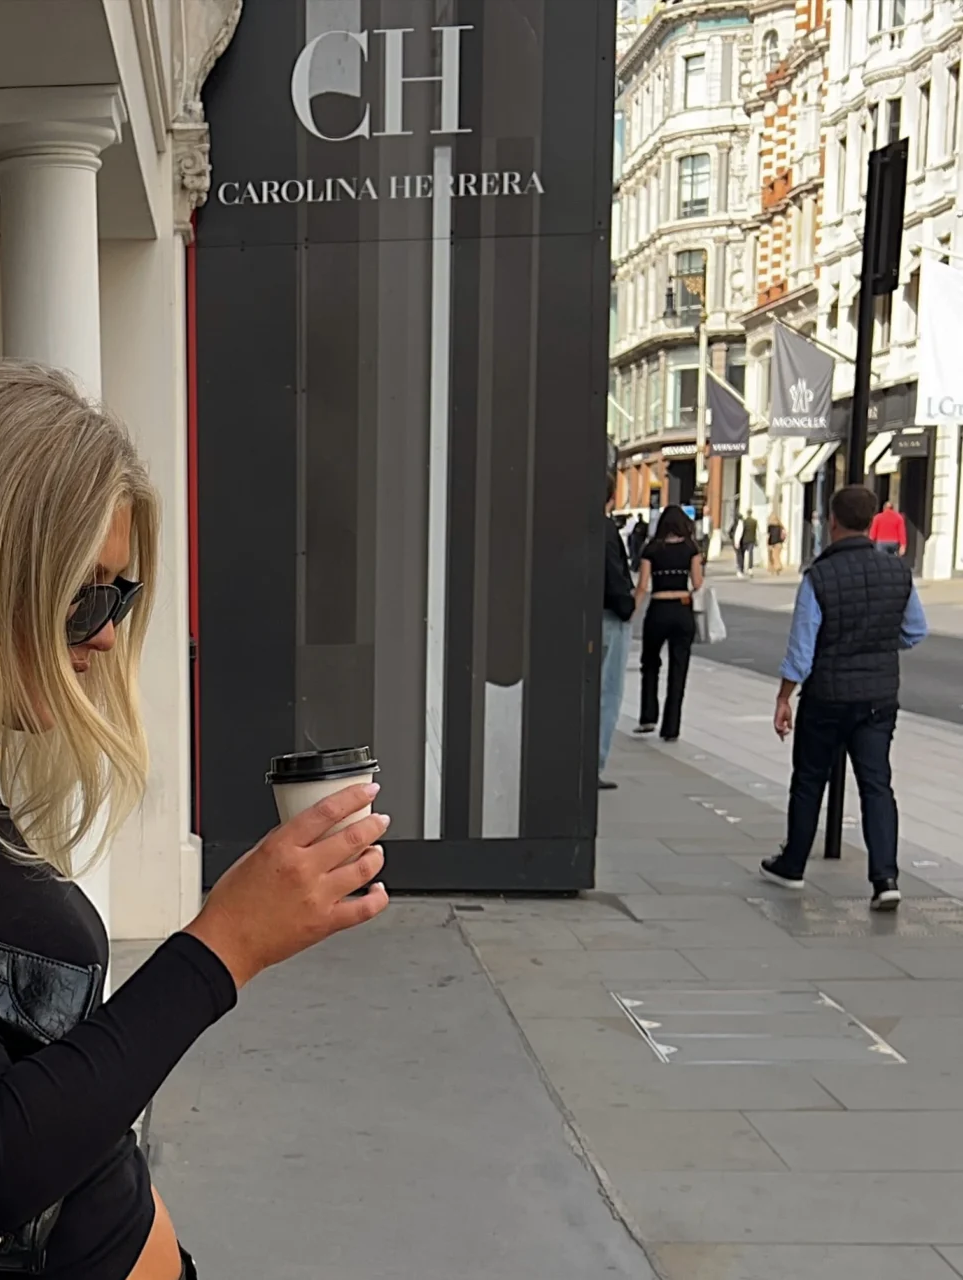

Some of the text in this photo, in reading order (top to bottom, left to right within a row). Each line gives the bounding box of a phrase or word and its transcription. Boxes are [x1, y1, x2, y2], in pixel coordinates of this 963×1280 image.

[291, 25, 474, 141] CH
[217, 177, 378, 206] CAROLINA
[771, 416, 827, 429] MONCLER
